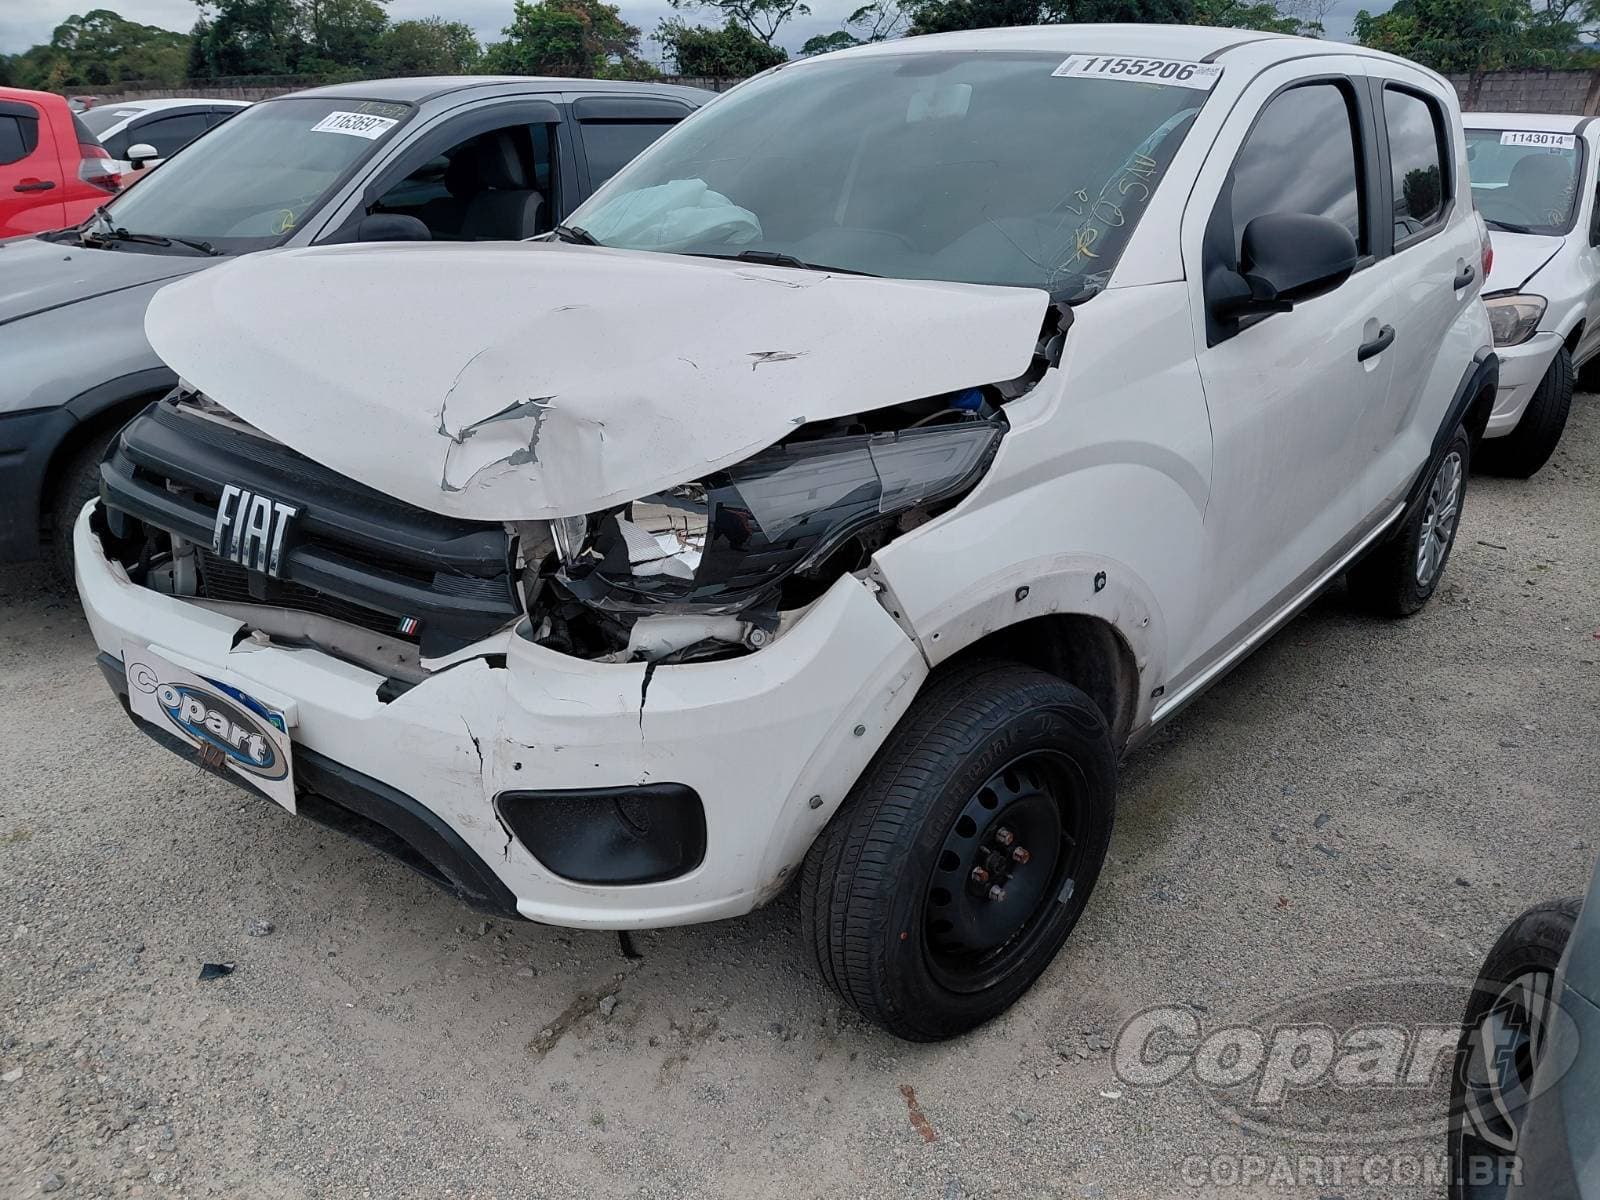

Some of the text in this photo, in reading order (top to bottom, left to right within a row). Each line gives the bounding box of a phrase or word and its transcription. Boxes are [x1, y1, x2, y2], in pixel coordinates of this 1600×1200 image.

[1082, 57, 1198, 81] 1155206
[327, 115, 386, 132] 1163697
[1511, 133, 1564, 145] 1143014
[213, 484, 296, 577] FIAT
[128, 662, 267, 763] Copart
